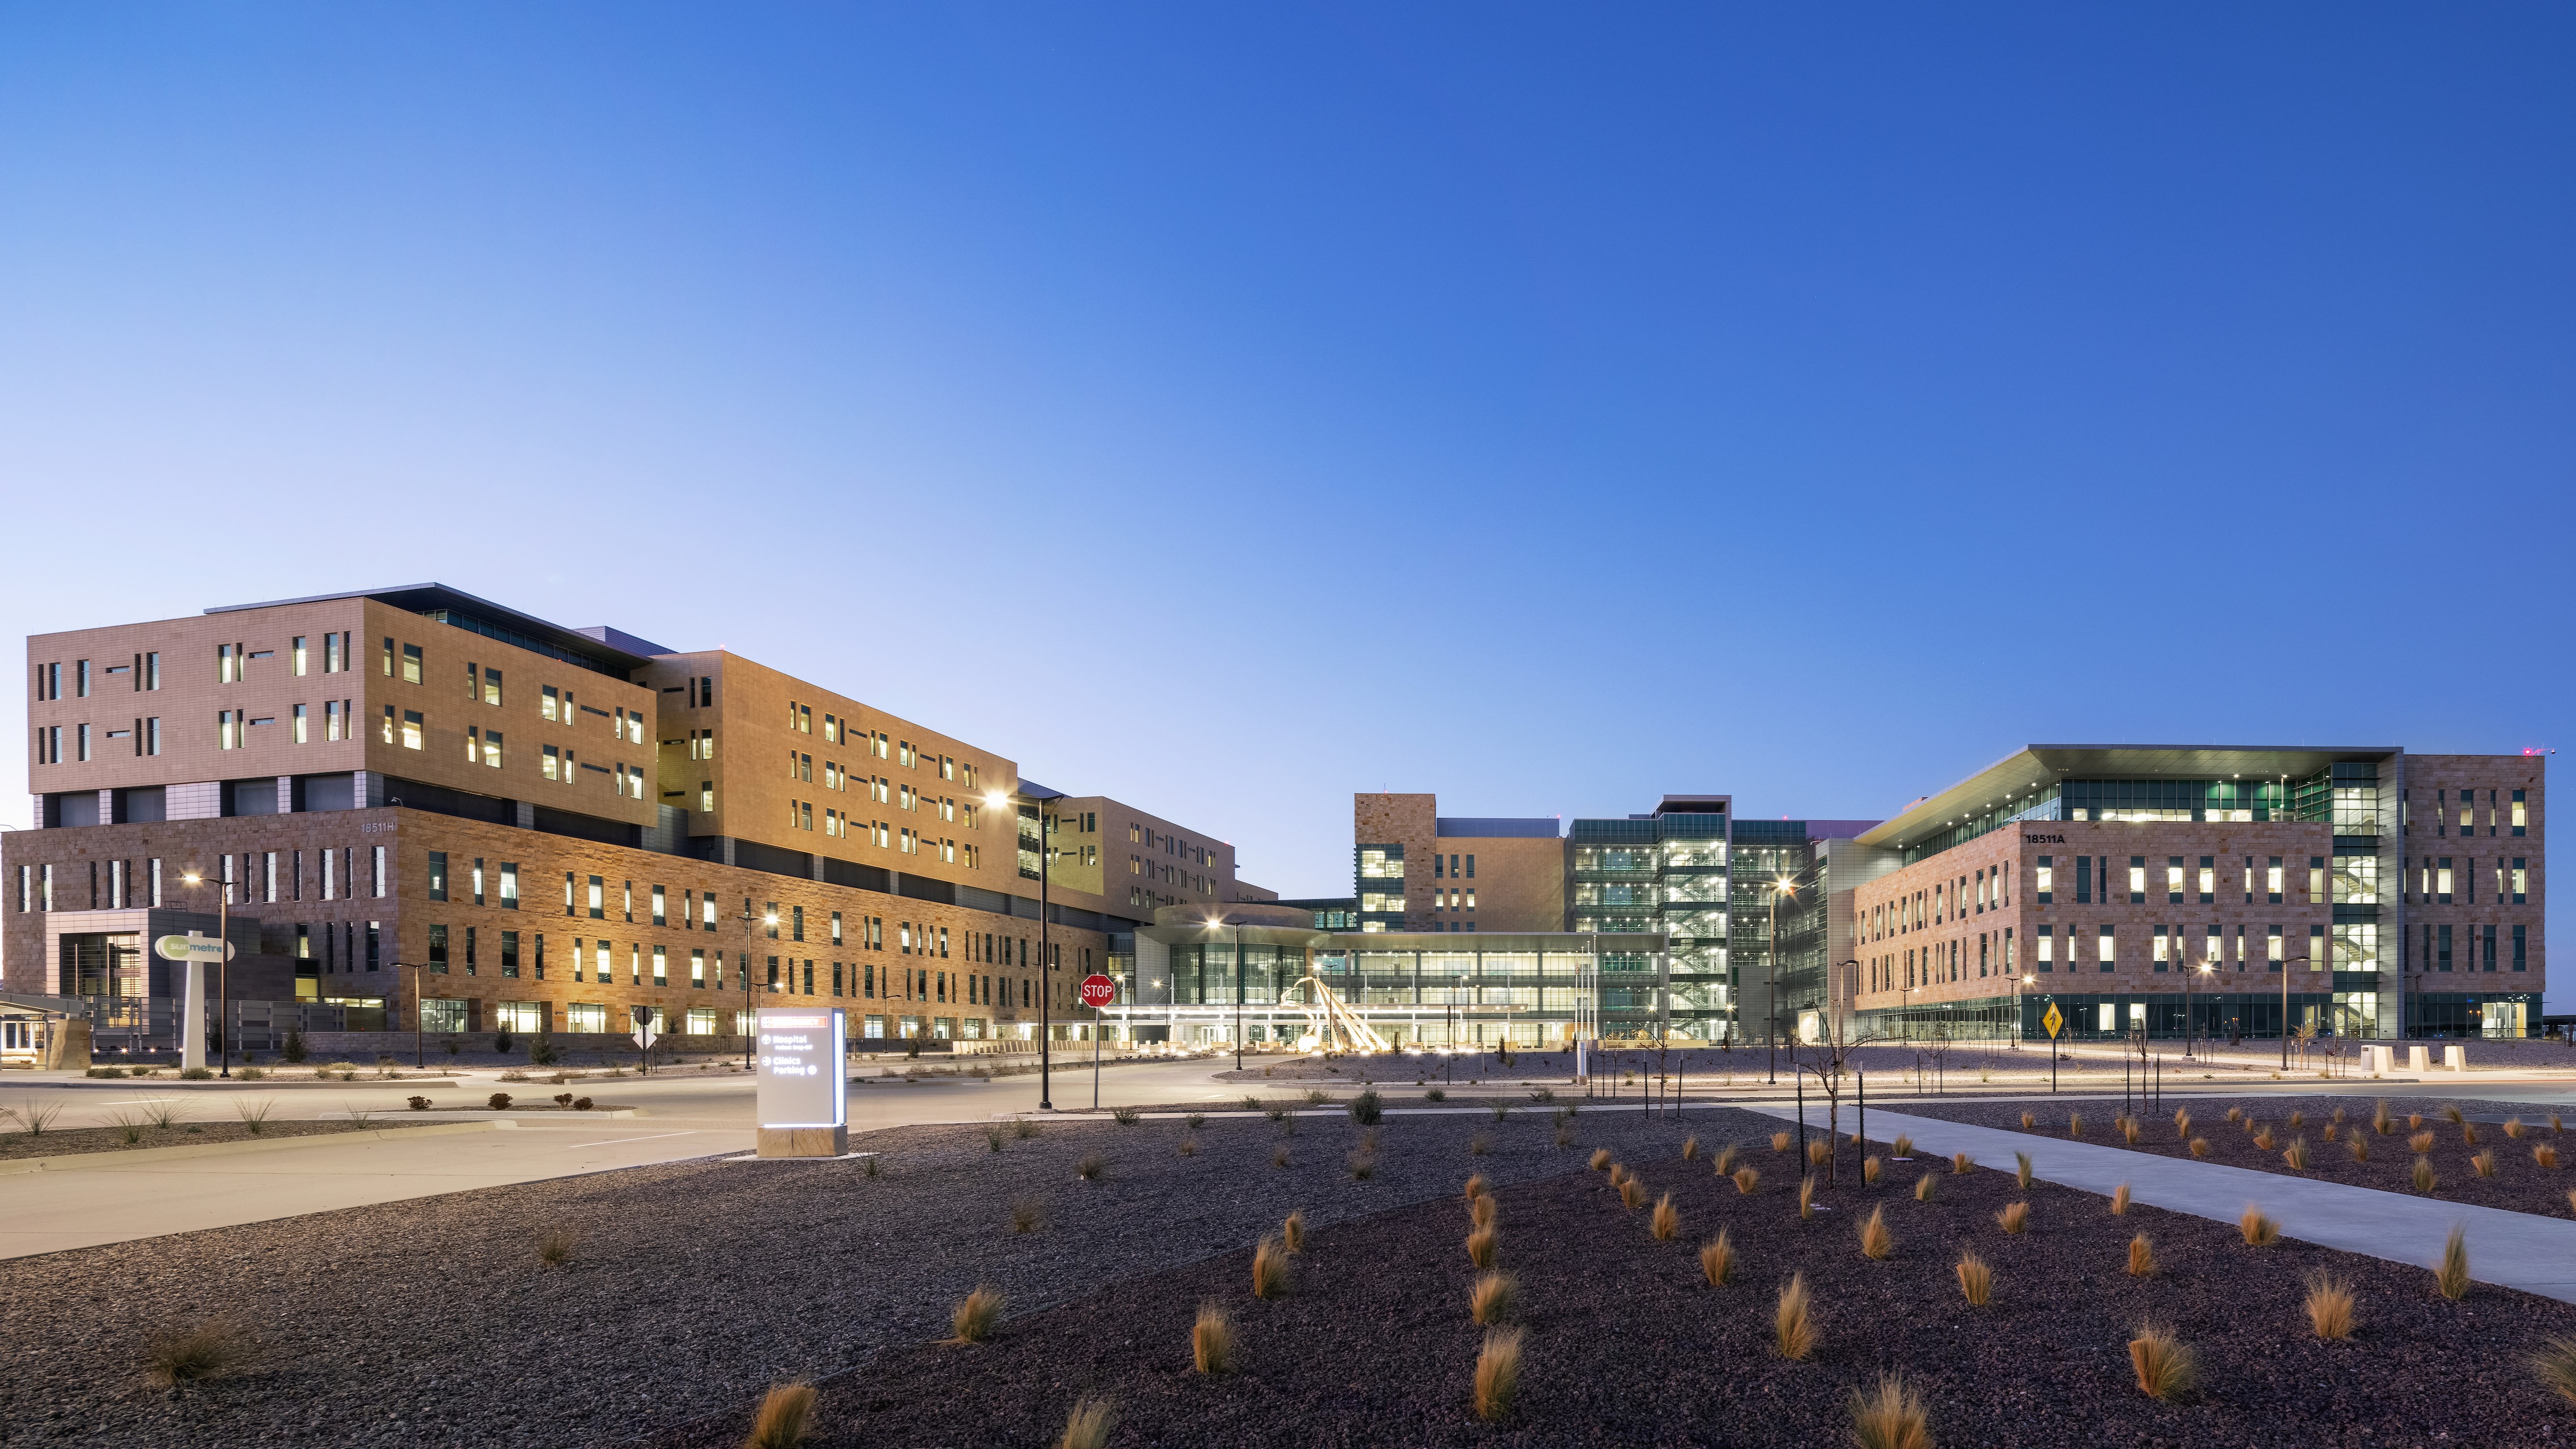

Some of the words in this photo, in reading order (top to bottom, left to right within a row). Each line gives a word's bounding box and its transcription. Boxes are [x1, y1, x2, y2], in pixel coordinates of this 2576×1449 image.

[361, 822, 394, 833] 18511H
[2026, 834, 2065, 843] 18511A
[1083, 985, 1112, 998] STOP
[773, 1035, 807, 1045] Hospital
[773, 1066, 805, 1076] Parking
